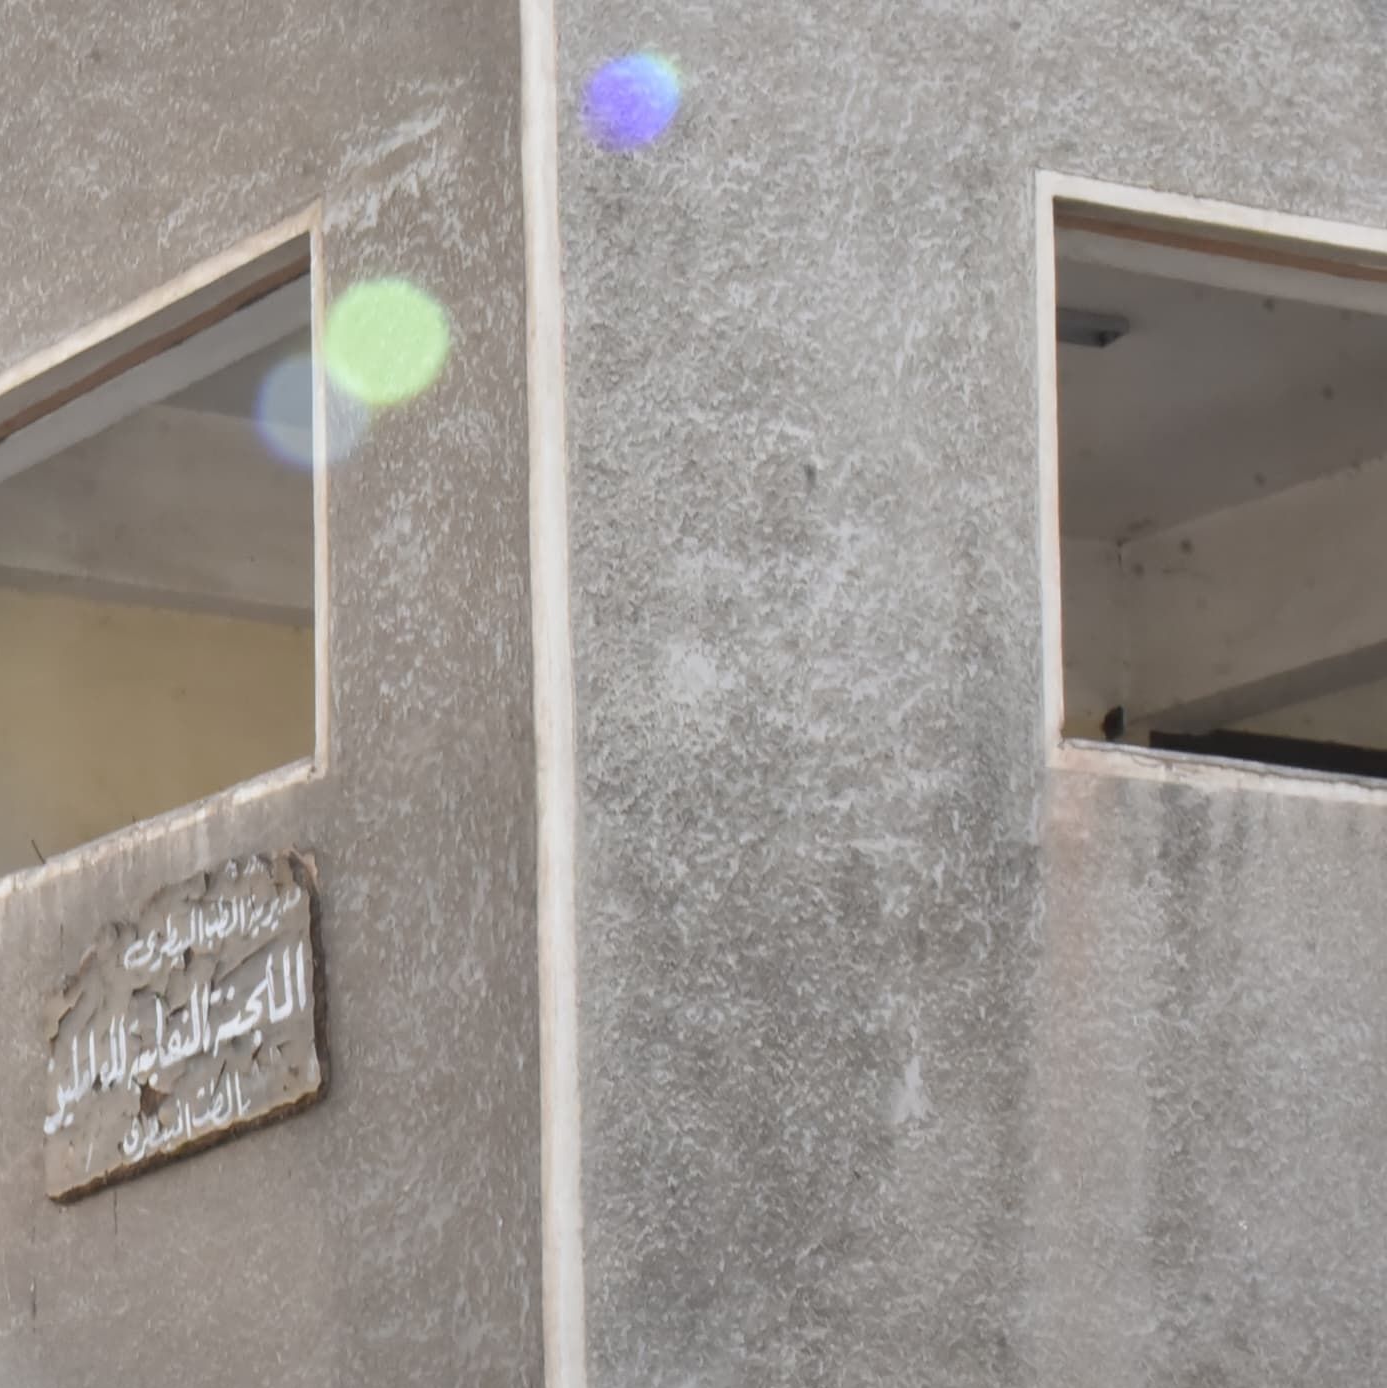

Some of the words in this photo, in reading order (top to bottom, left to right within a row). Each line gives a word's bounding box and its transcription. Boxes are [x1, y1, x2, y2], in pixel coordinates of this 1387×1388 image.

[205, 894, 246, 950] الطب
[127, 981, 211, 1094] النقابية
[209, 941, 307, 1058] اللجنة
